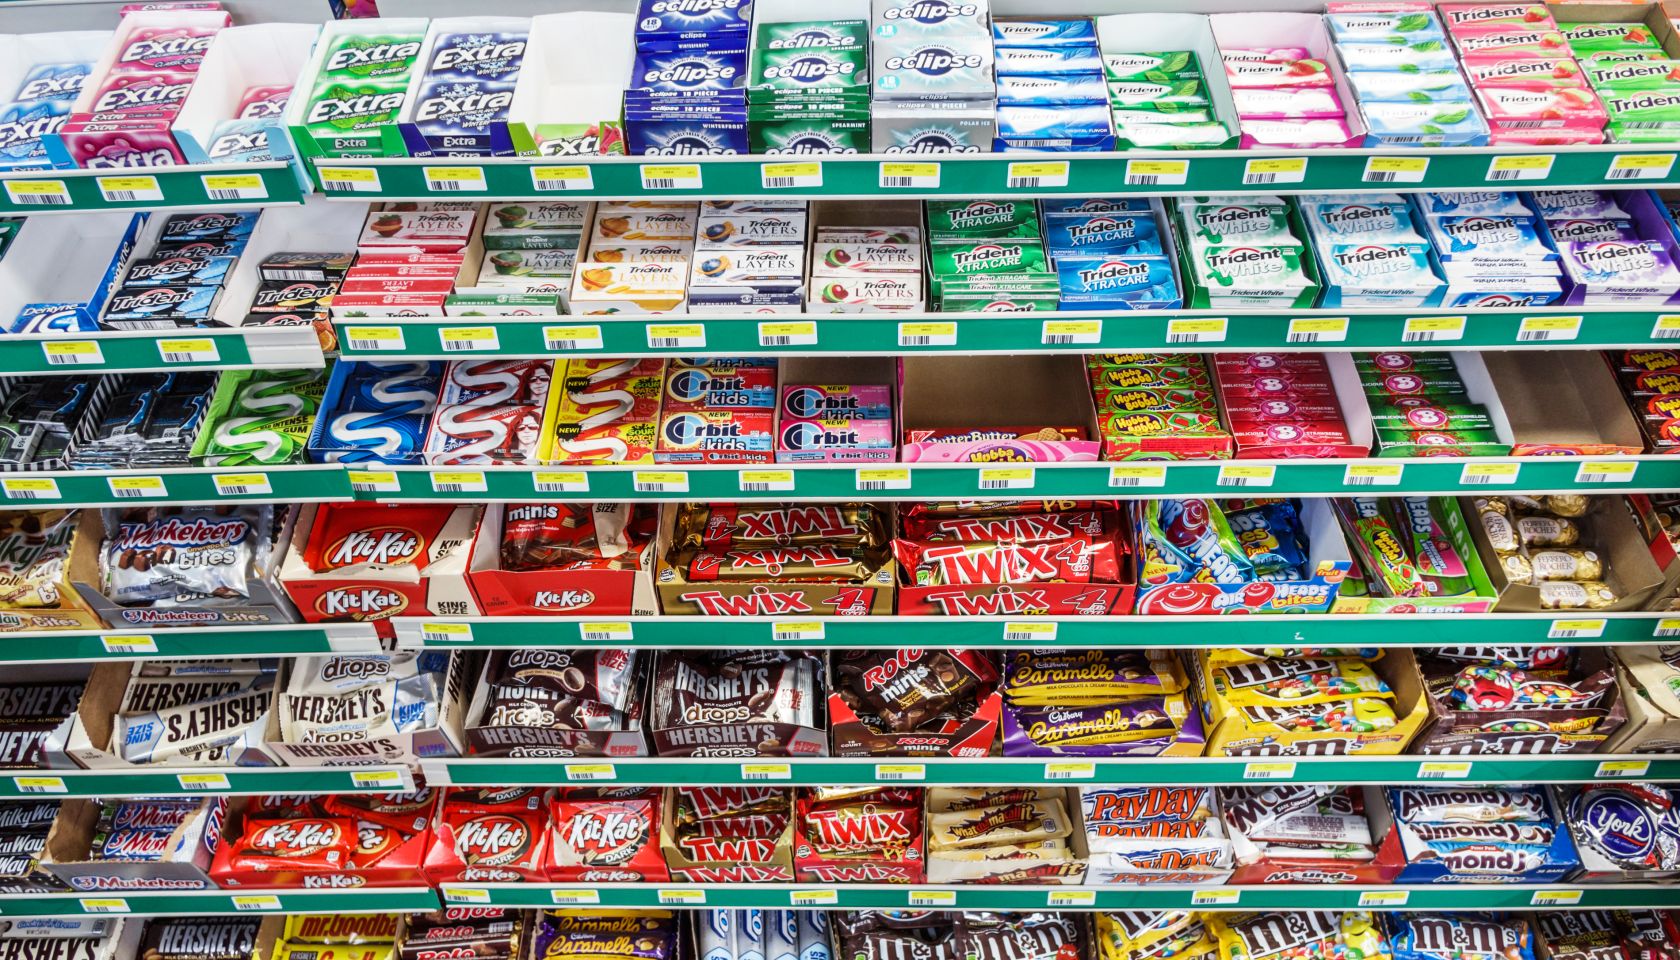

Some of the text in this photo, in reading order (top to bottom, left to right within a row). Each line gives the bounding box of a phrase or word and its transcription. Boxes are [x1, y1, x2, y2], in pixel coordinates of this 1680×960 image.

[646, 18, 658, 26] 18
[1450, 7, 1525, 23] Trident
[1004, 25, 1049, 33] Trident
[119, 36, 215, 63] Extra
[326, 41, 422, 72] Extra
[432, 40, 527, 72] Extra
[763, 56, 855, 79] eclipse
[887, 52, 983, 75] eclipse
[1109, 58, 1155, 66] Trident
[1480, 61, 1553, 79] Trident
[644, 59, 735, 83] eclipse
[1592, 65, 1670, 82] Trident
[94, 82, 192, 112] Extra
[1500, 95, 1548, 103] Trident
[306, 92, 408, 124] Extra
[92, 113, 125, 122] Extra
[83, 124, 118, 132] Extra
[334, 138, 367, 149] Extra
[528, 210, 584, 219] LAYERS
[538, 205, 577, 213] Trident
[1199, 209, 1269, 226] Trident
[167, 215, 245, 235] Trident
[408, 221, 464, 229] LAYERS
[418, 214, 460, 222] Trident
[635, 221, 693, 229] LAYERS
[740, 226, 798, 235] LAYERS
[1209, 220, 1271, 235] White
[1445, 218, 1514, 236] Trident
[1071, 229, 1135, 246] XTRA CARE
[1460, 230, 1519, 246] White
[954, 246, 1022, 264] Trident
[1208, 249, 1281, 268] Trident
[1575, 244, 1648, 263] Trident
[131, 258, 213, 280] Trident
[955, 257, 1021, 274] XTRA CARE
[1080, 262, 1148, 282] Trident
[112, 291, 196, 311] Trident
[258, 284, 341, 305] Trident
[23, 303, 79, 317] Dentyne
[1109, 368, 1142, 381] Hubba
[1121, 374, 1152, 387] Bubba
[666, 369, 744, 403] Orbit
[710, 391, 748, 406] kids
[786, 388, 859, 417] Orbit
[1114, 391, 1147, 404] Hubba
[1127, 396, 1159, 410] Bubba
[283, 426, 308, 434] GUM
[626, 428, 655, 436] SOUR
[508, 505, 559, 521] minis
[595, 505, 617, 513] SIZE
[125, 518, 248, 546] Musketeers
[1523, 526, 1557, 535] ROCHER
[178, 550, 235, 570] bites
[1146, 566, 1168, 575] NEW
[1316, 568, 1340, 576] fruit
[1213, 584, 1330, 609] AIR HEADS
[1271, 595, 1327, 608] bites
[141, 610, 219, 622] Musketeers
[509, 649, 572, 667] drops
[599, 658, 625, 671] SIZE
[322, 658, 390, 682] drops
[863, 649, 924, 692] Rolo
[1010, 664, 1116, 686] Caramello
[880, 664, 932, 703] minis
[128, 683, 240, 712] HERSHEY'S
[288, 688, 385, 724] HERSHEY'S
[399, 702, 426, 717] KING
[685, 703, 751, 724] drops
[1048, 710, 1083, 723] Cadbury
[127, 722, 154, 736] SIZE
[1029, 709, 1131, 742] Caramello
[480, 727, 589, 746] HERSHEY'S
[665, 723, 778, 746] HERSHEY'S
[179, 743, 208, 755] HERSHEY'S
[285, 739, 397, 759] HERSHEY'S
[496, 787, 524, 801] DARK
[1402, 788, 1500, 818] Almond
[1597, 804, 1651, 842] York
[485, 853, 515, 867] DARK
[605, 847, 635, 863] DARK
[100, 877, 206, 889] Musketeers
[1265, 870, 1357, 883] Mounds
[158, 922, 257, 955] HERSHEY'S
[426, 927, 474, 939] Rolo
[545, 935, 634, 956] Caramello
